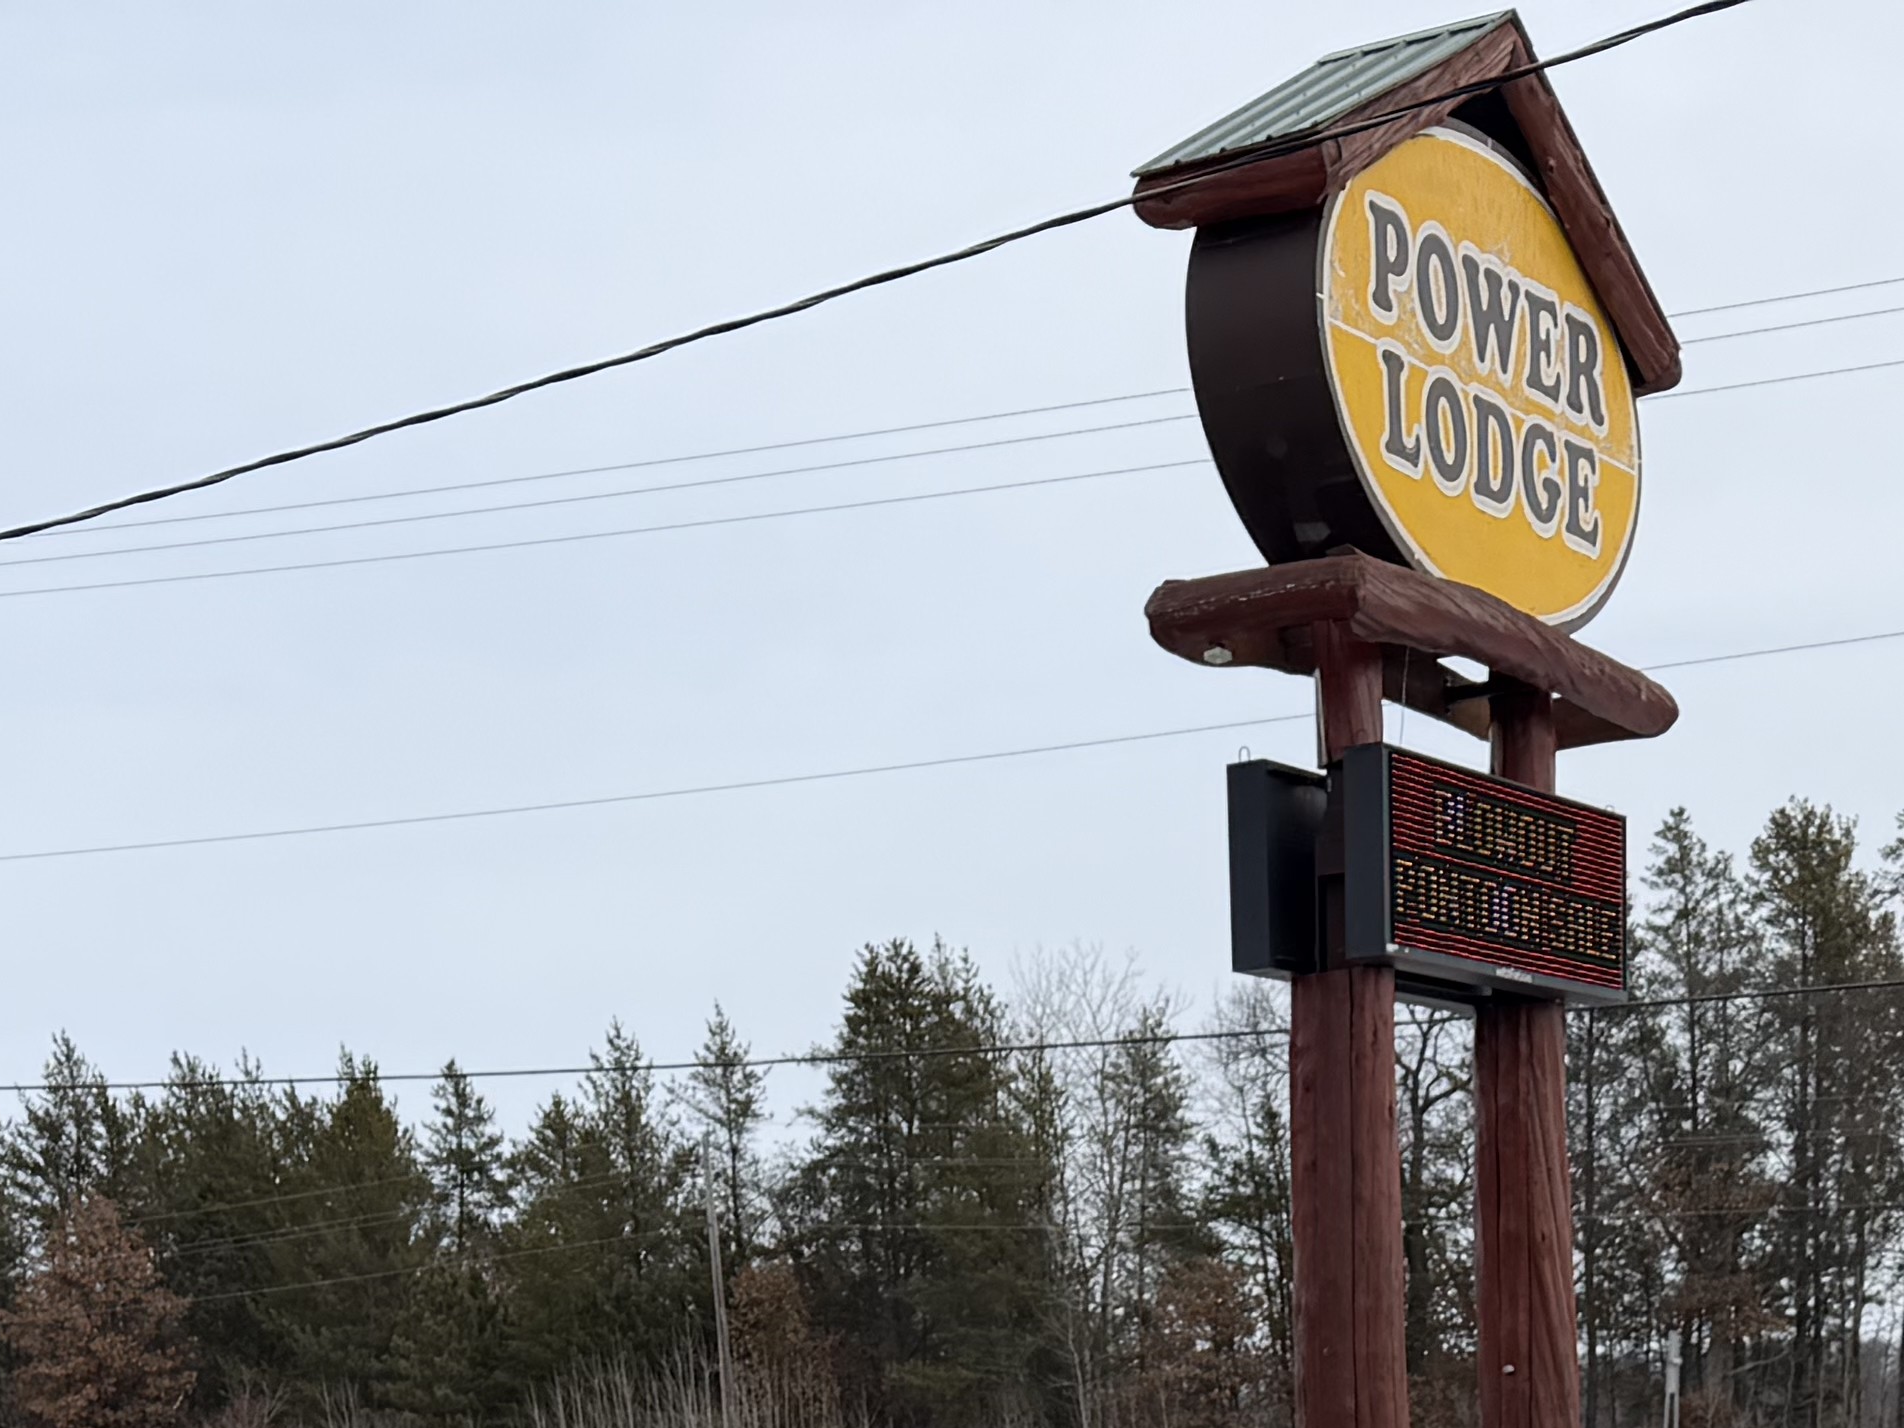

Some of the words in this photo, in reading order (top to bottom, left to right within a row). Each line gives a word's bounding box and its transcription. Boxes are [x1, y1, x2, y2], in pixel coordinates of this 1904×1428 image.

[1367, 194, 1607, 433] POWER
[1379, 343, 1601, 553] LODGE
[1435, 789, 1574, 877] BLOWOUT
